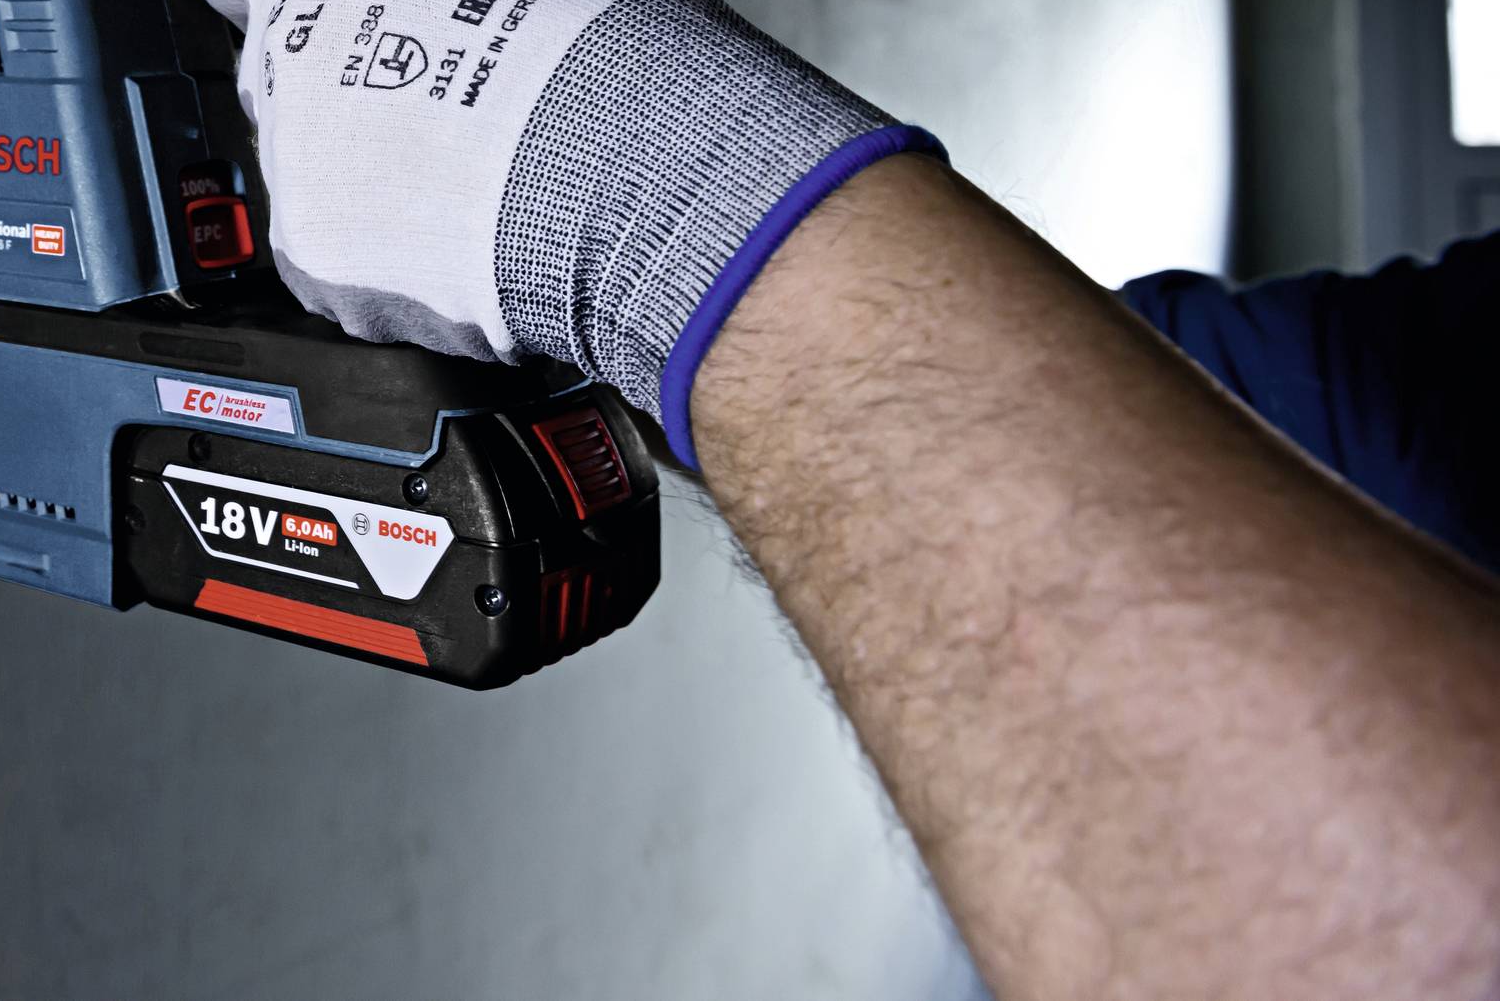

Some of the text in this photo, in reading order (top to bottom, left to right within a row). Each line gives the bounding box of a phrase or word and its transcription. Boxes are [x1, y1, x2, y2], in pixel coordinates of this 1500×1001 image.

[341, 55, 363, 86] EN
[429, 49, 466, 100] 3131
[460, 56, 497, 107] MADE
[487, 36, 508, 53] IN
[180, 177, 220, 196] 100%
[194, 224, 222, 243] EPC
[183, 389, 266, 413] EC brushless
[221, 407, 262, 422] motor
[378, 520, 437, 546] BOSCH
[285, 540, 319, 558] Li-Ion
